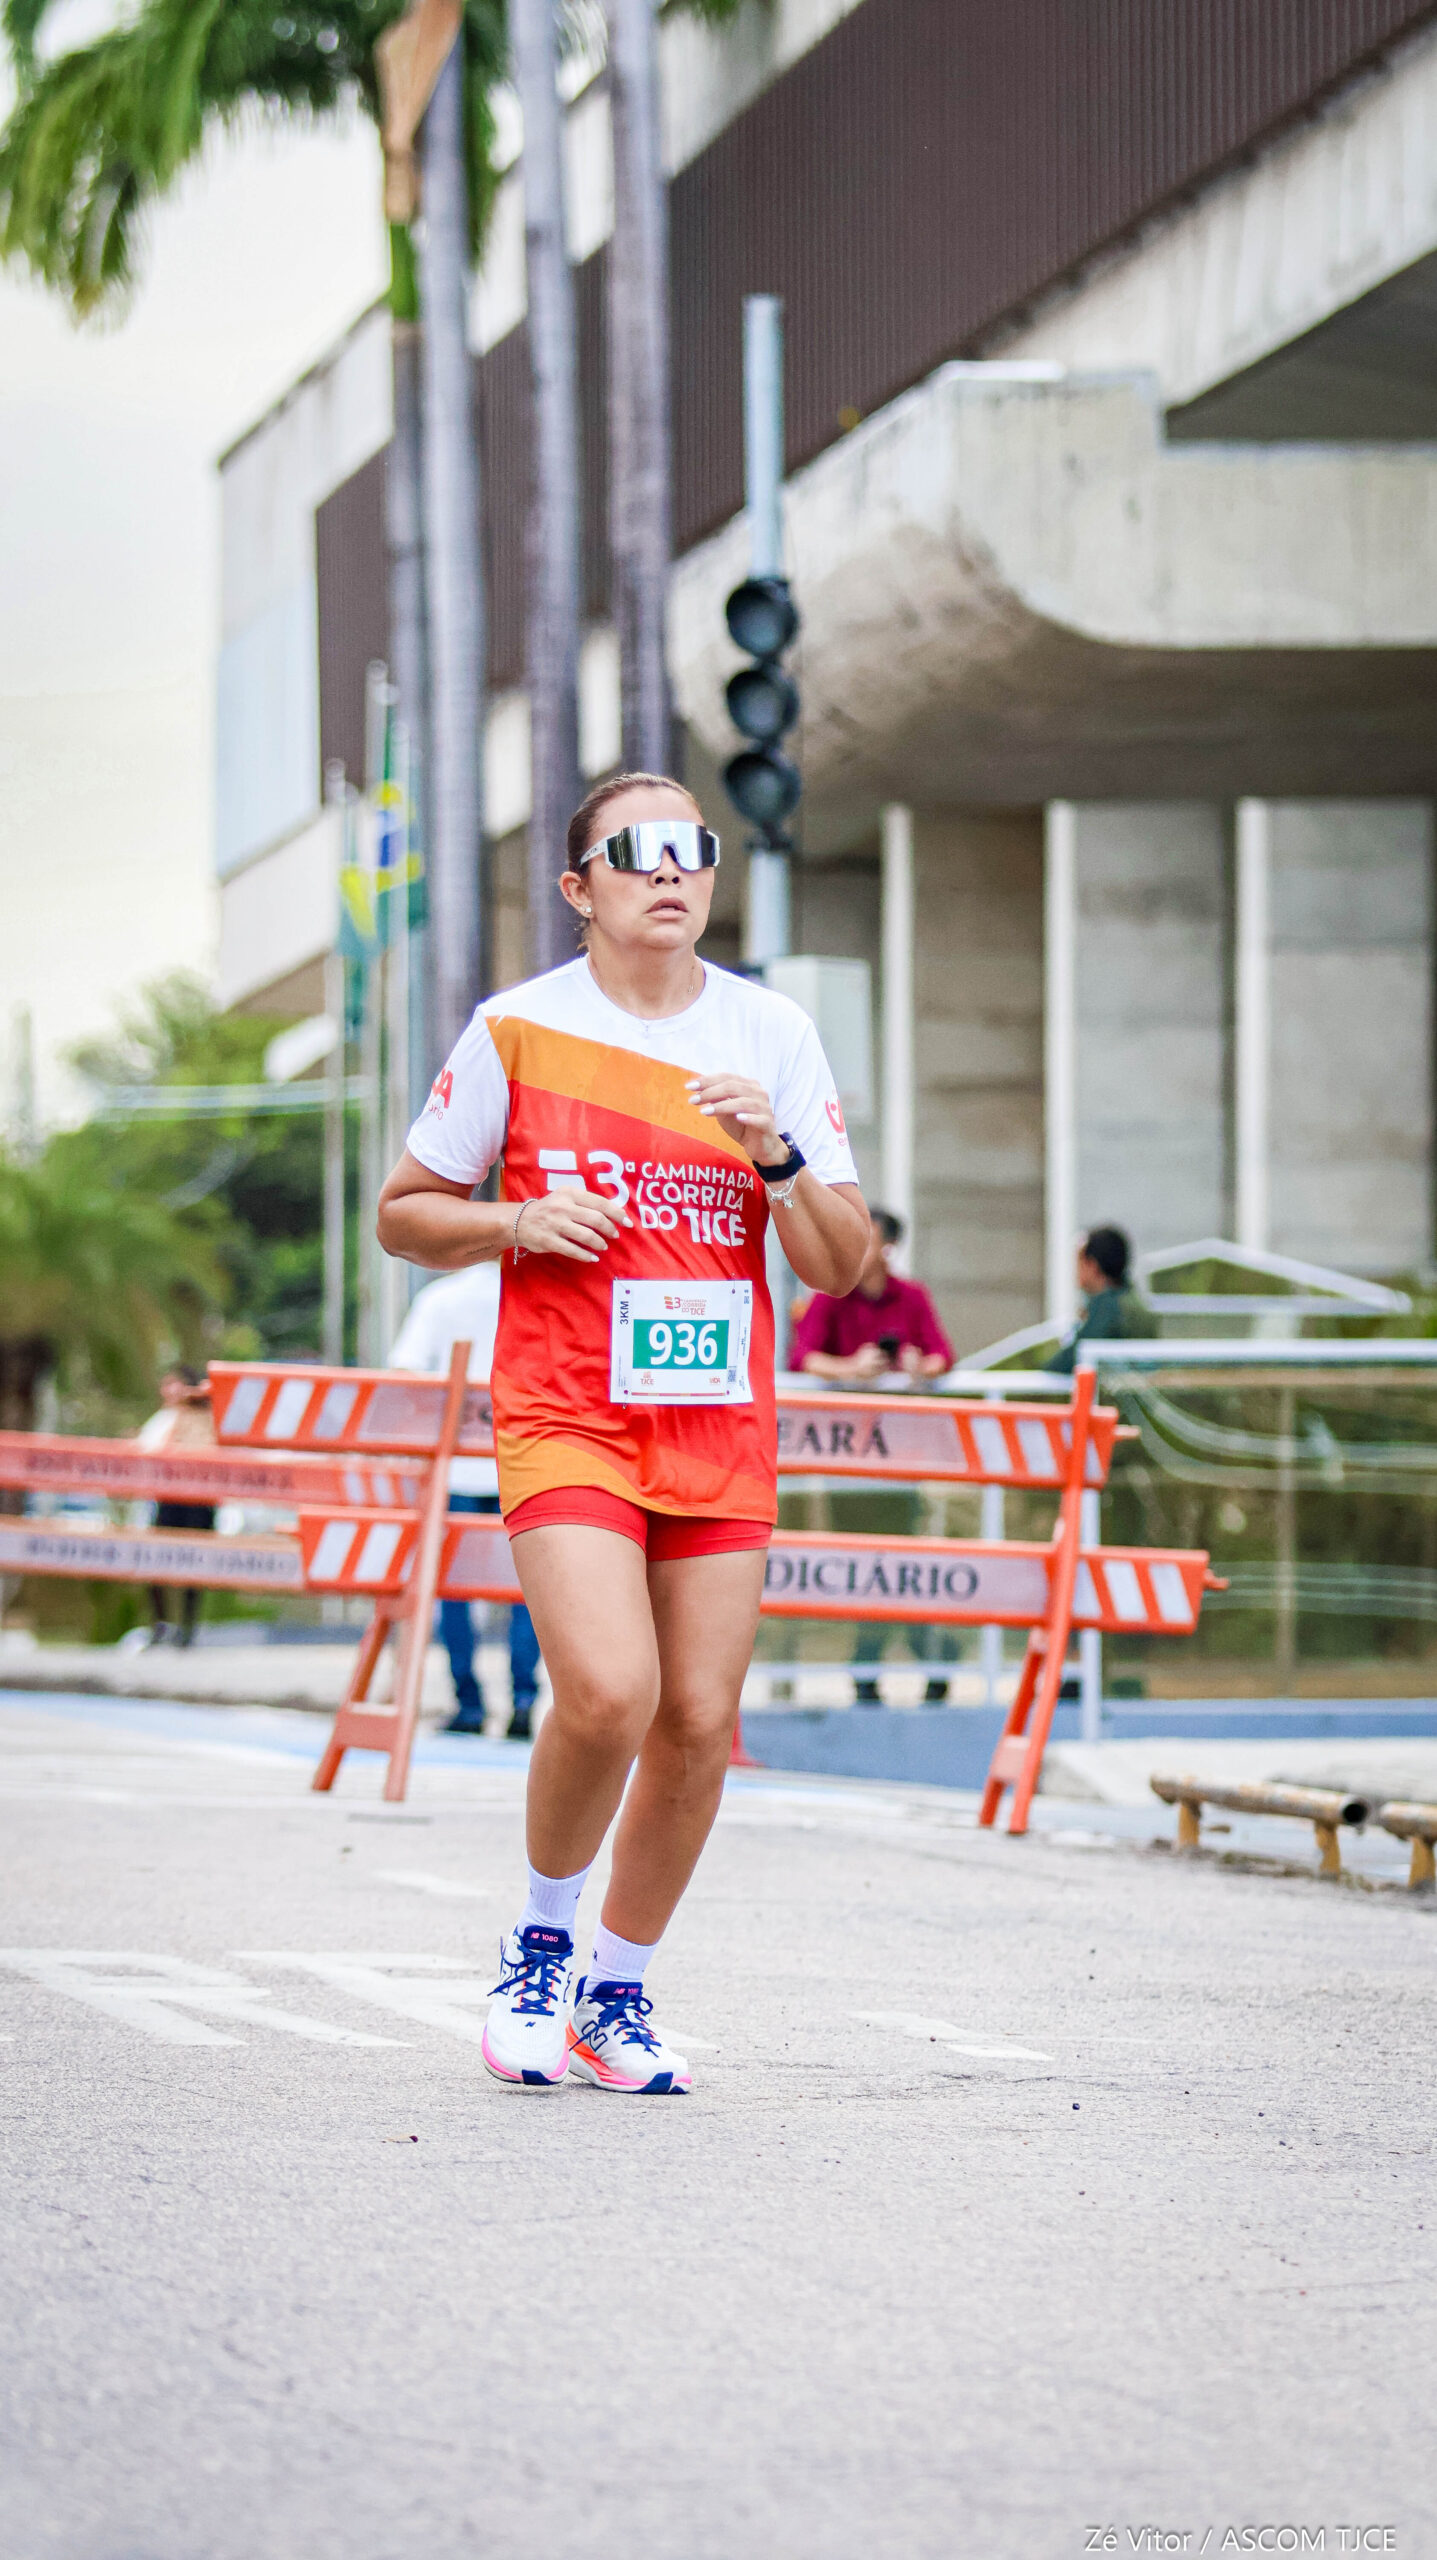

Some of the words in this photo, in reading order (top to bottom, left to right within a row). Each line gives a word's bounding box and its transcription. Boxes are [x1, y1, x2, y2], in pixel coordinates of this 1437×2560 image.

[641, 1161, 754, 1191] CAMINHADA
[638, 1204, 678, 1231] DO
[619, 1300, 629, 1325] 3KM
[648, 1322, 718, 1366] 936
[542, 1934, 559, 1943] 1080
